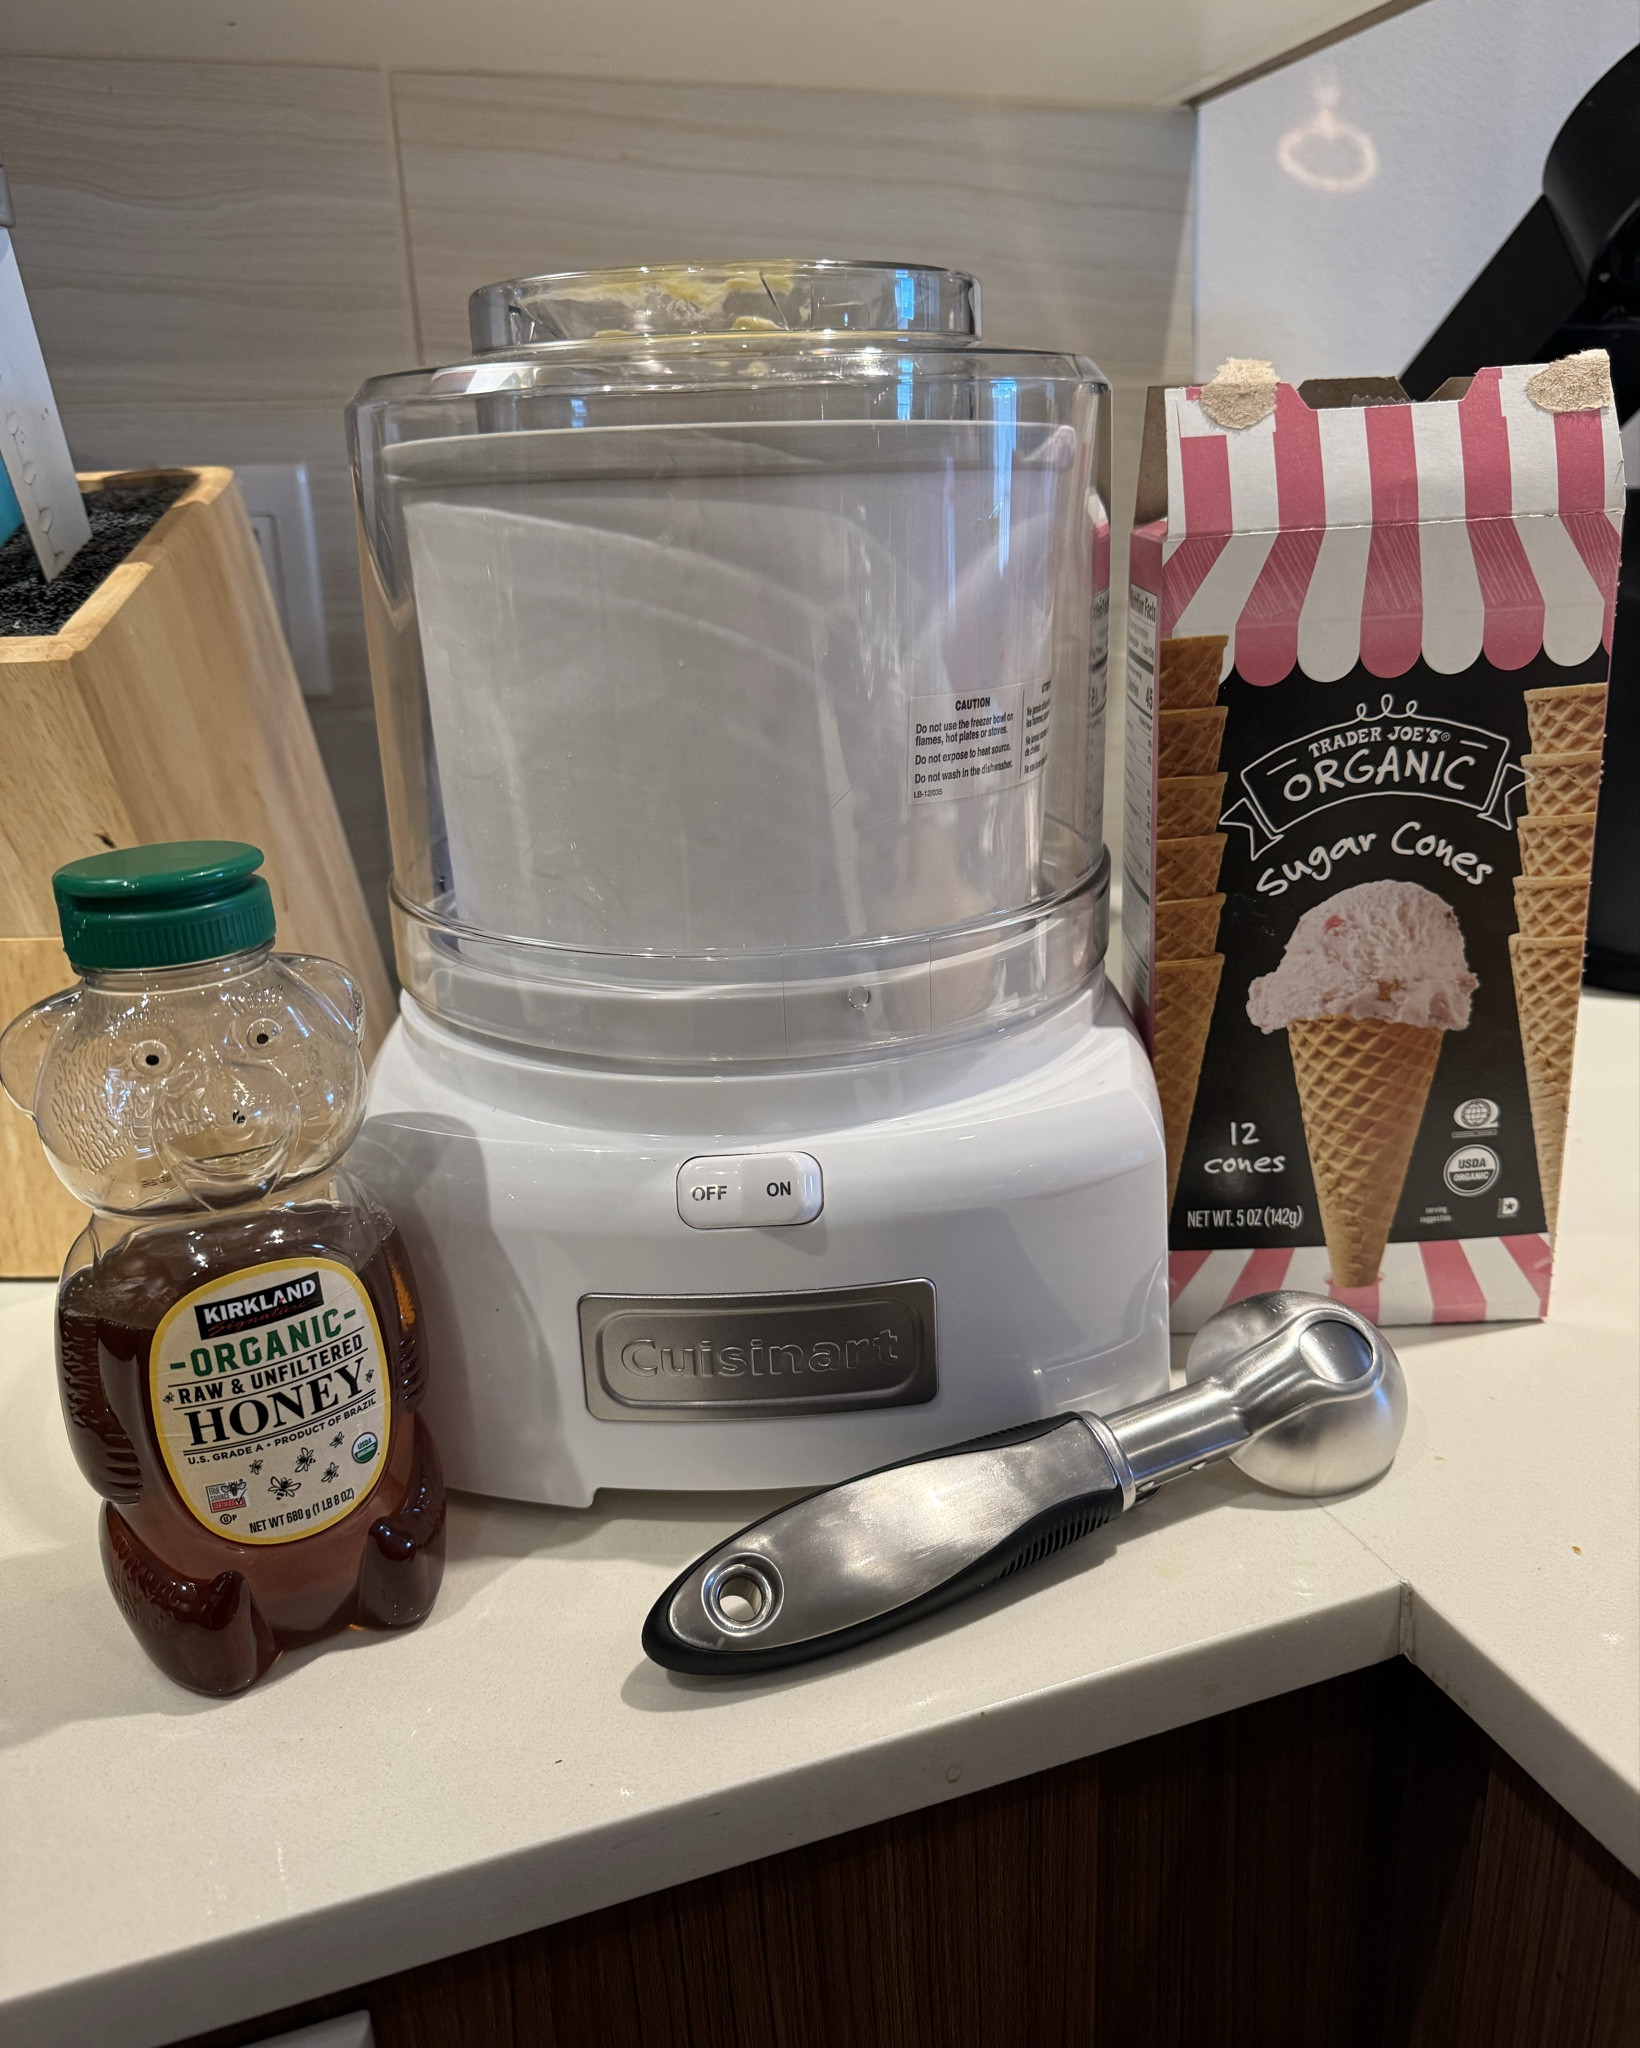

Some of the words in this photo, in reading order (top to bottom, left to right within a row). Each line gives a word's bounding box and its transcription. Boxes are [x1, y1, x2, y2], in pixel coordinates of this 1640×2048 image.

[955, 697, 991, 711] CAUTION
[1145, 686, 1153, 710] 45
[916, 723, 928, 734] Do
[929, 722, 942, 733] not
[943, 722, 957, 731] use
[958, 719, 970, 730] the
[970, 717, 992, 728] freezer
[992, 712, 1006, 724] bowl
[1006, 713, 1014, 721] on
[915, 735, 944, 747] flames,
[945, 732, 958, 743] hot
[959, 730, 979, 744] plates
[980, 730, 988, 738] or
[988, 726, 1008, 737] stoves.
[1308, 726, 1382, 758] TRADER
[915, 754, 927, 765] Do
[928, 753, 941, 764] not
[942, 751, 969, 763] expose
[969, 748, 977, 758] to
[977, 746, 991, 757] heat
[991, 743, 1011, 755] source.
[914, 773, 926, 784] Do
[928, 771, 941, 782] not
[942, 768, 961, 781] wash
[961, 767, 969, 778] in
[970, 766, 981, 776] the
[1283, 746, 1475, 801] ORGANIC
[1256, 832, 1377, 896] Sugar
[1391, 822, 1493, 885] Cones
[1230, 1121, 1260, 1146] 12
[1203, 1155, 1286, 1174] cones
[1458, 1158, 1486, 1169] USDA
[1453, 1171, 1490, 1182] ORGANIC
[691, 1185, 728, 1202] OFF
[766, 1181, 792, 1198] ON
[1187, 1209, 1210, 1228] NET
[1212, 1209, 1234, 1227] WT.
[1236, 1209, 1244, 1227] 5
[1246, 1208, 1262, 1226] OZ
[1264, 1205, 1303, 1229] (142g)
[203, 1279, 316, 1325] KIRKLAND
[207, 1299, 319, 1337] Signature
[620, 1328, 899, 1378] Cuisinart
[178, 1380, 223, 1404] RAW
[231, 1378, 245, 1394] &
[250, 1333, 363, 1390] UNFILTERED
[184, 1357, 364, 1446] HONEY
[188, 1456, 210, 1465] U.S.
[212, 1446, 253, 1461] GRADE
[255, 1443, 264, 1452] A
[274, 1422, 325, 1446] PRODUCT
[328, 1414, 342, 1427] OF
[344, 1398, 376, 1420] BRAZIL
[357, 1437, 372, 1450] USDA
[249, 1520, 267, 1534] NET
[268, 1514, 285, 1528] WT
[286, 1508, 304, 1523] 680
[305, 1510, 311, 1520] g
[312, 1502, 320, 1516] (1
[321, 1498, 333, 1511] LB
[334, 1494, 340, 1506] 8
[340, 1487, 355, 1503] OZ)
